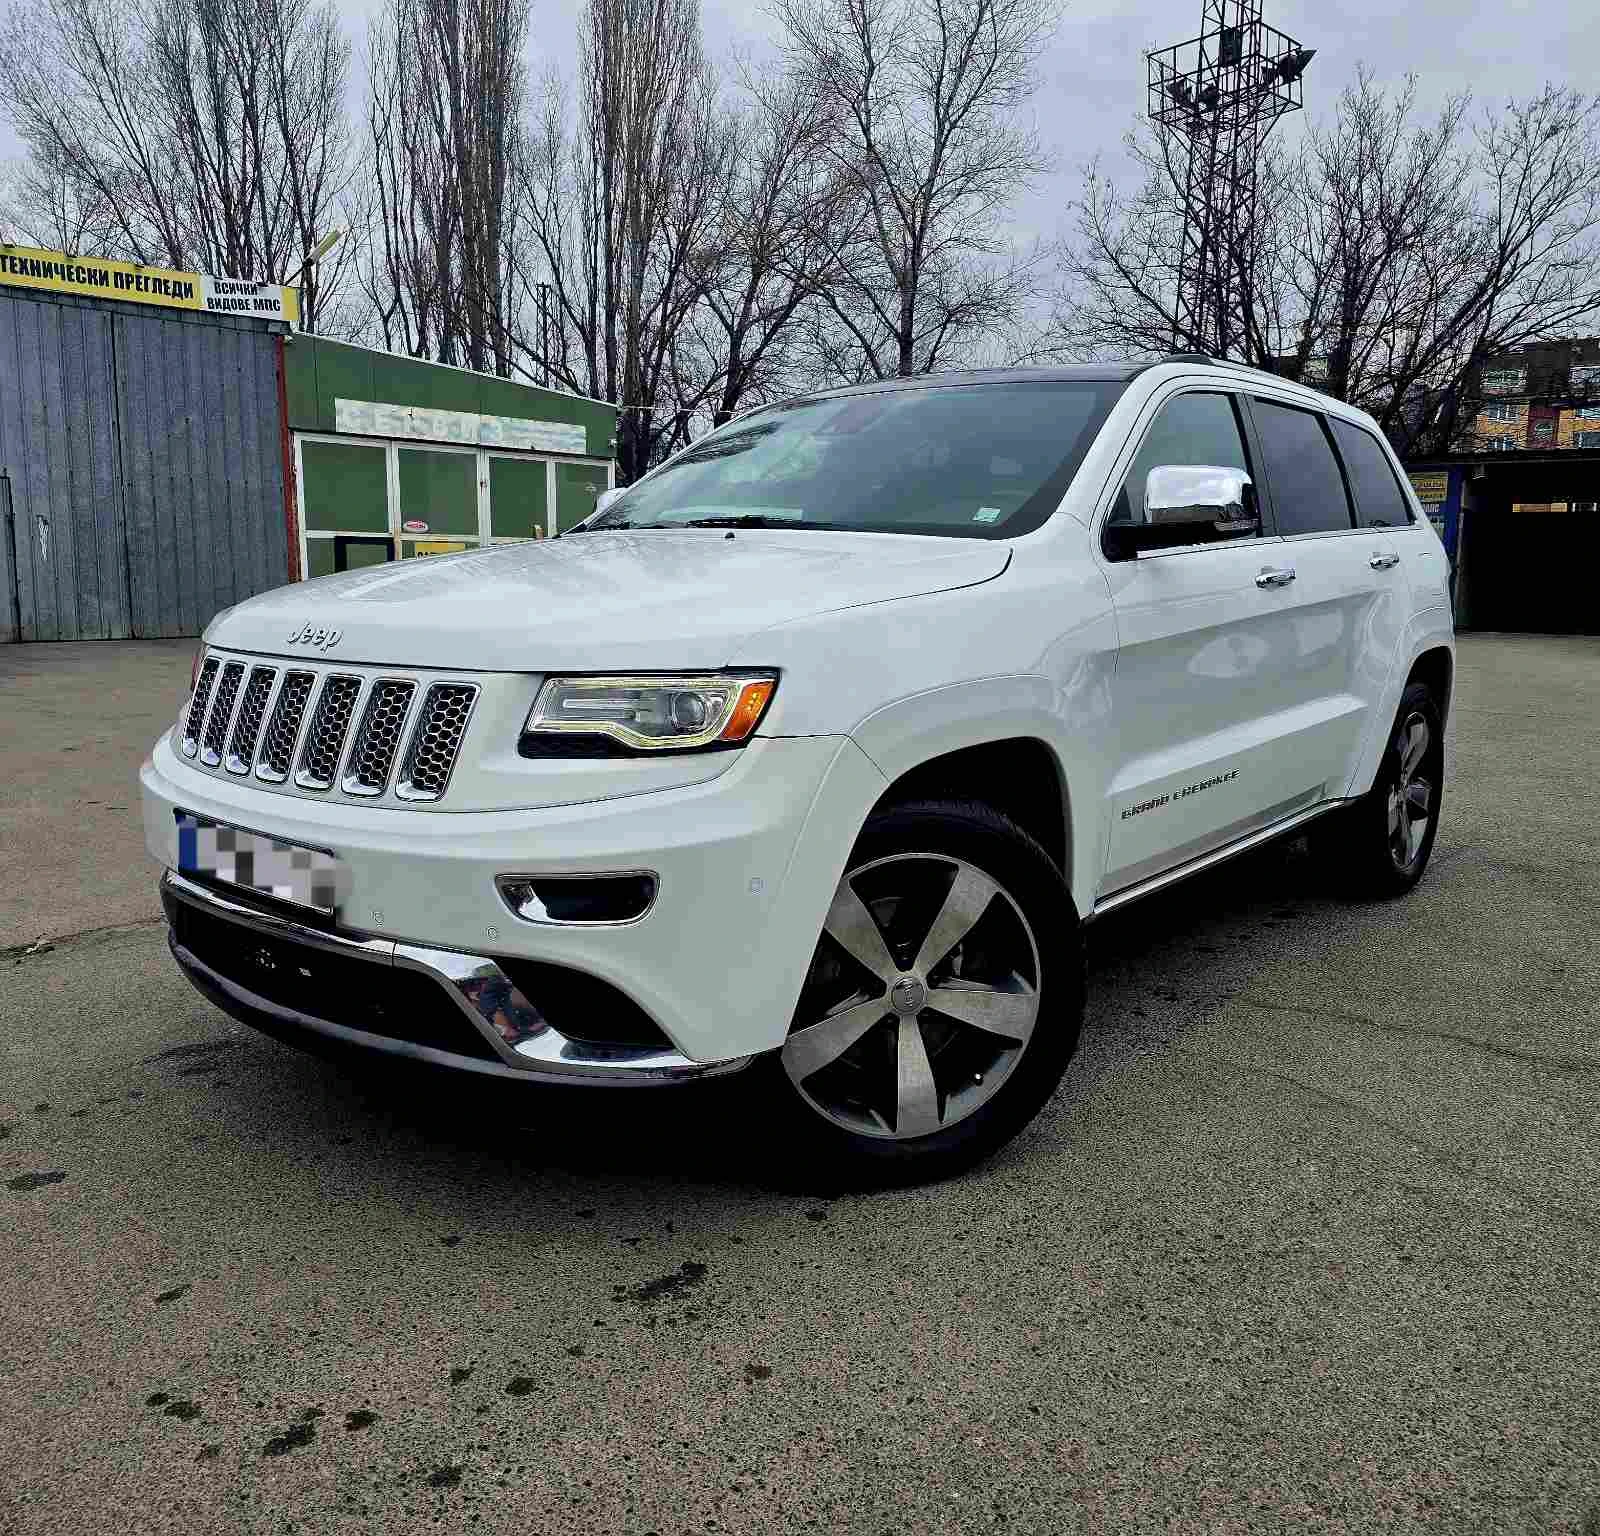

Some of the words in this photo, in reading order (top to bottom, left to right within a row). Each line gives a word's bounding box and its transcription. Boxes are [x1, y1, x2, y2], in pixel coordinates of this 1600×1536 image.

[0, 255, 110, 287] ТЕХНИЧЕСКИ
[113, 271, 194, 301] ПРЕГЛЕДИ
[213, 281, 257, 296] ВСИЧКИ
[206, 297, 251, 312] ВИДОВЕ
[253, 299, 281, 312] МПС
[286, 621, 343, 653] Jeep
[1121, 795, 1170, 819] GRAND
